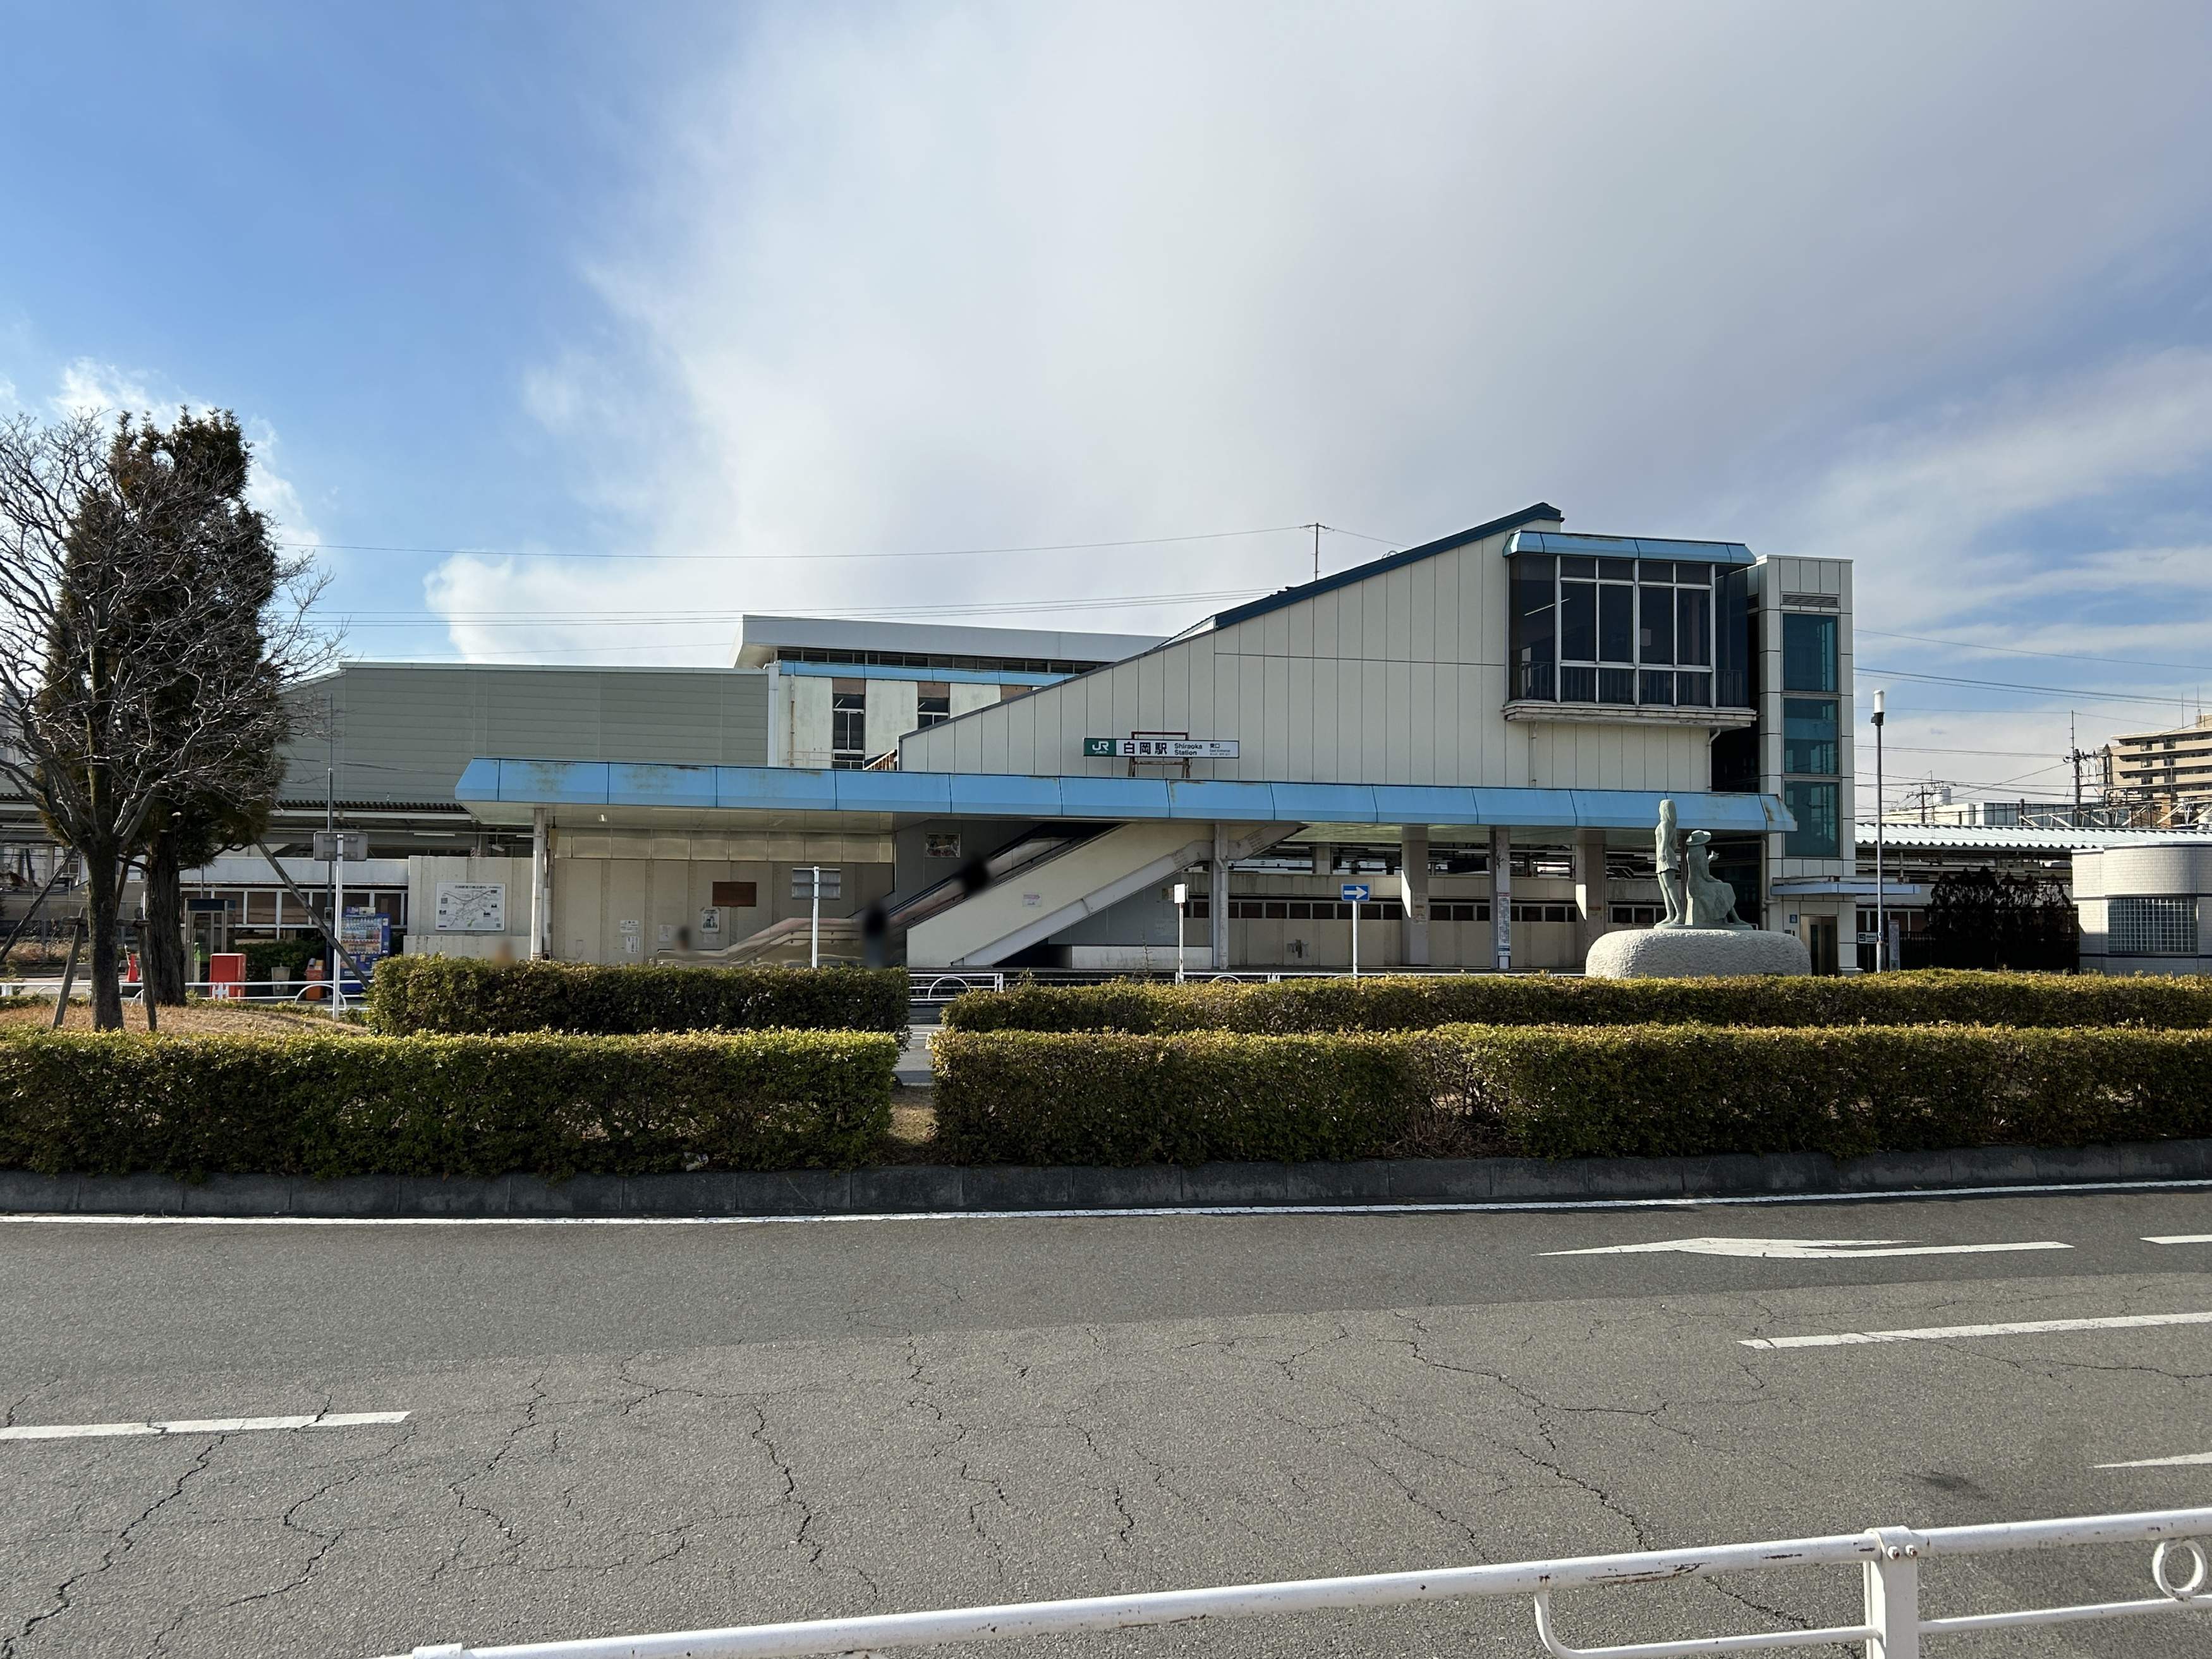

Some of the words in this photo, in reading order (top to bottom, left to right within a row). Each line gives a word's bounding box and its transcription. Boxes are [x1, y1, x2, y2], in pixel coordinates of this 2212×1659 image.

[1092, 741, 1109, 751] JR
[1124, 741, 1167, 755] 白岡駅
